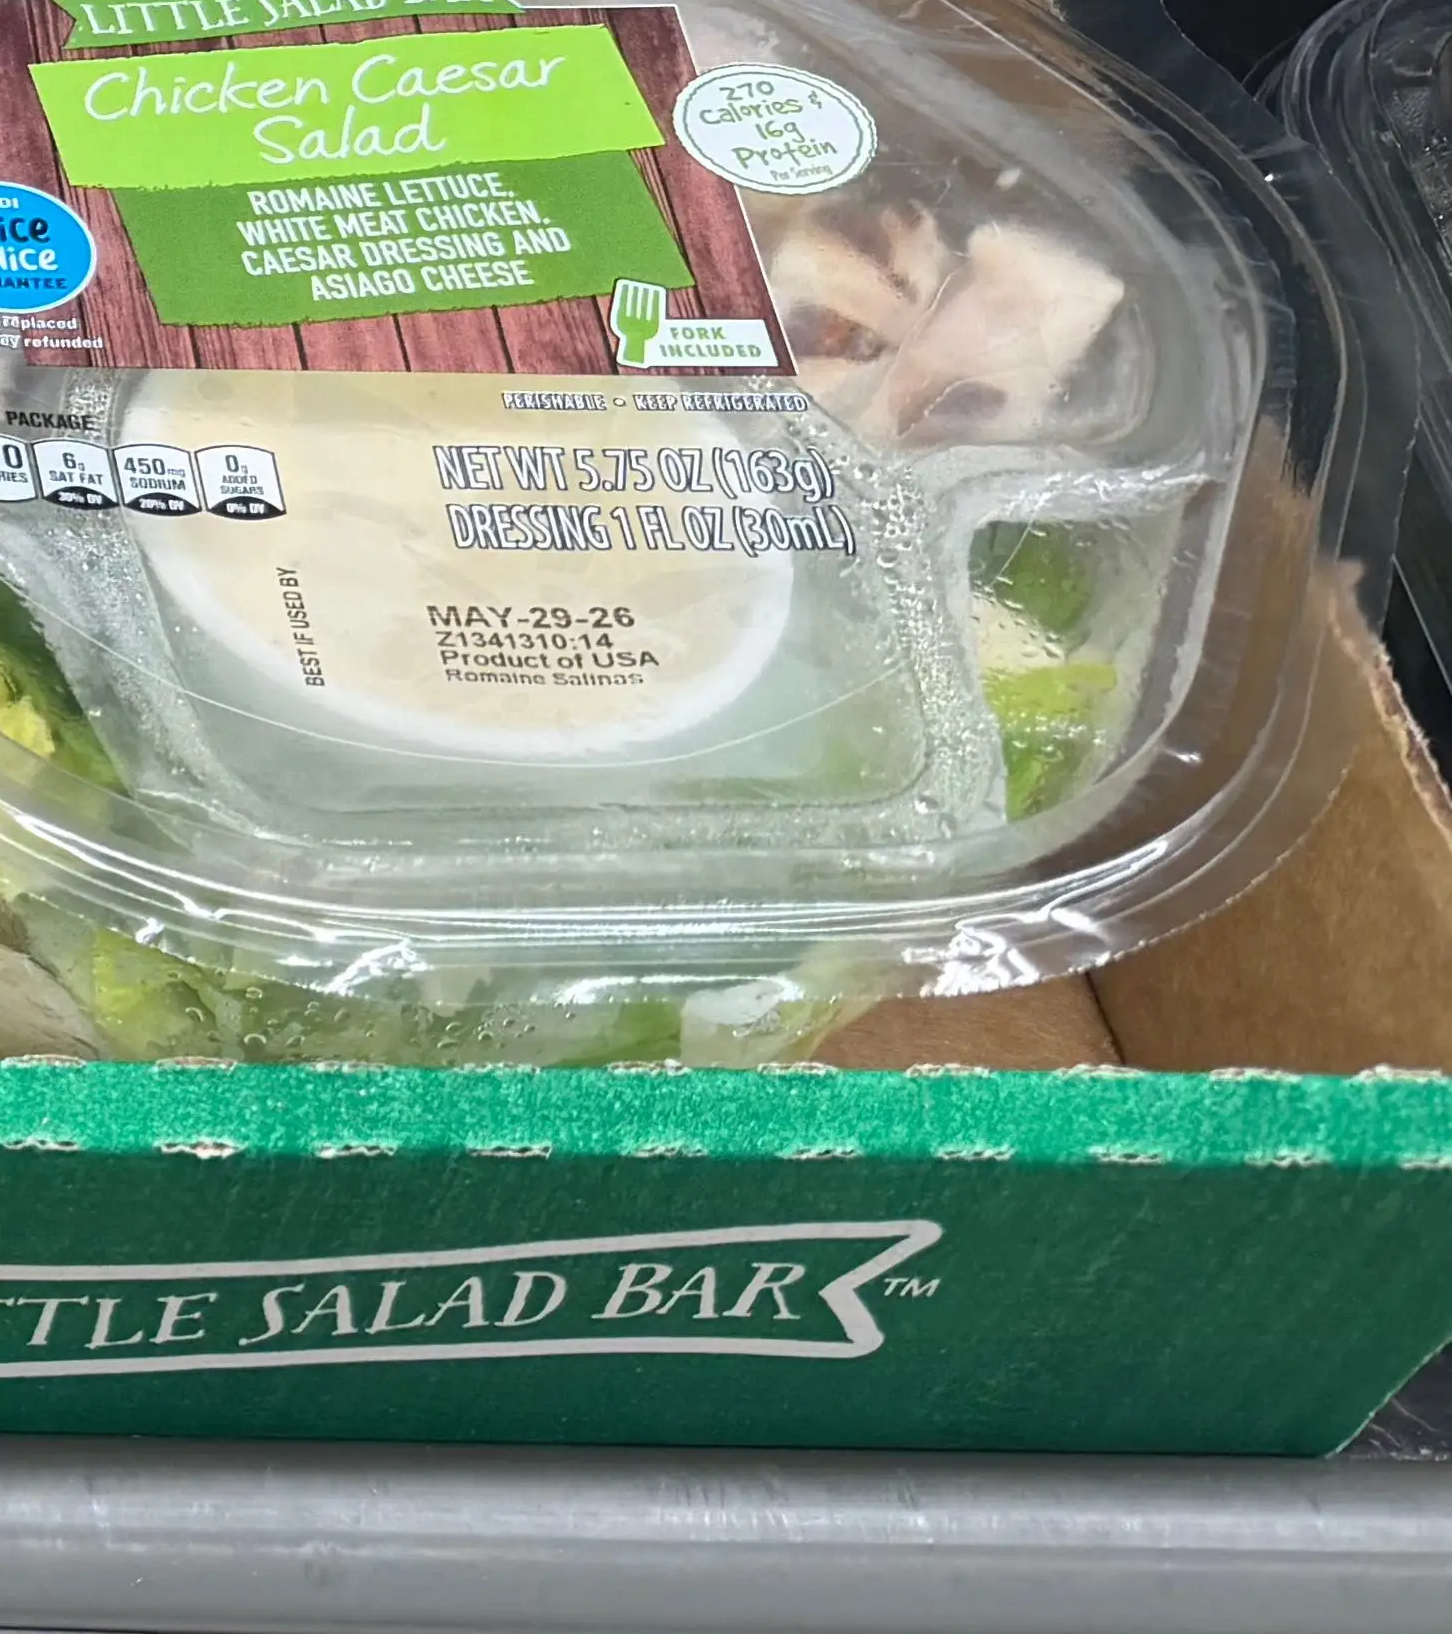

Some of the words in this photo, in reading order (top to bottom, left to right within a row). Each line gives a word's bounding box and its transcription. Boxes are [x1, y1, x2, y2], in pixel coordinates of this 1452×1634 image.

[84, 62, 331, 121] Chicken
[351, 54, 568, 104] Caesar
[719, 80, 775, 102] 270
[699, 98, 804, 125] Calories
[253, 102, 448, 165] Salad
[756, 120, 806, 144] 16g
[731, 139, 838, 169] Protein
[247, 182, 384, 216] ROMAINE
[236, 215, 332, 247] WHITE
[334, 210, 410, 240] MEAT
[240, 245, 358, 277] CAESAR
[359, 230, 506, 267] DRESSING
[513, 226, 572, 256] AND
[310, 268, 416, 303] ASIAGO
[420, 260, 535, 292] CHEESE
[2, 314, 78, 330] replaced
[24, 335, 104, 349] refunded
[669, 327, 727, 341] FORK
[659, 344, 762, 358] INCLUDED
[502, 391, 608, 411] PERISHABLE
[633, 393, 678, 411] KEEP
[681, 393, 809, 412] REFRIGERATED
[6, 410, 104, 432] PACKAGE
[49, 470, 75, 483] SAT
[79, 471, 104, 486] FAT
[129, 476, 187, 491] SODIUM
[222, 474, 258, 485] ADDED
[432, 445, 503, 491] NET
[503, 446, 569, 492] WT
[573, 447, 655, 493] 5.75
[658, 447, 714, 493] OZ
[712, 446, 835, 504] (163g)
[219, 485, 265, 497] SUGARS
[446, 503, 613, 552] DRESSING
[610, 506, 636, 551] 1
[639, 506, 685, 552] FL
[681, 506, 735, 553] OZ
[732, 504, 857, 558] (30mL)
[275, 566, 299, 588] BY
[282, 590, 310, 629] USED
[427, 604, 636, 629] MAY-29-26
[294, 629, 316, 650] IF
[435, 631, 614, 650] Z1341310:14
[304, 650, 326, 687] BEST
[440, 650, 551, 670] Product
[556, 651, 584, 669] of
[588, 651, 660, 669] USA
[445, 669, 548, 685] Romaine
[552, 671, 645, 686] Salinas
[237, 1269, 568, 1348] SALAD
[590, 1259, 809, 1322] BAR
